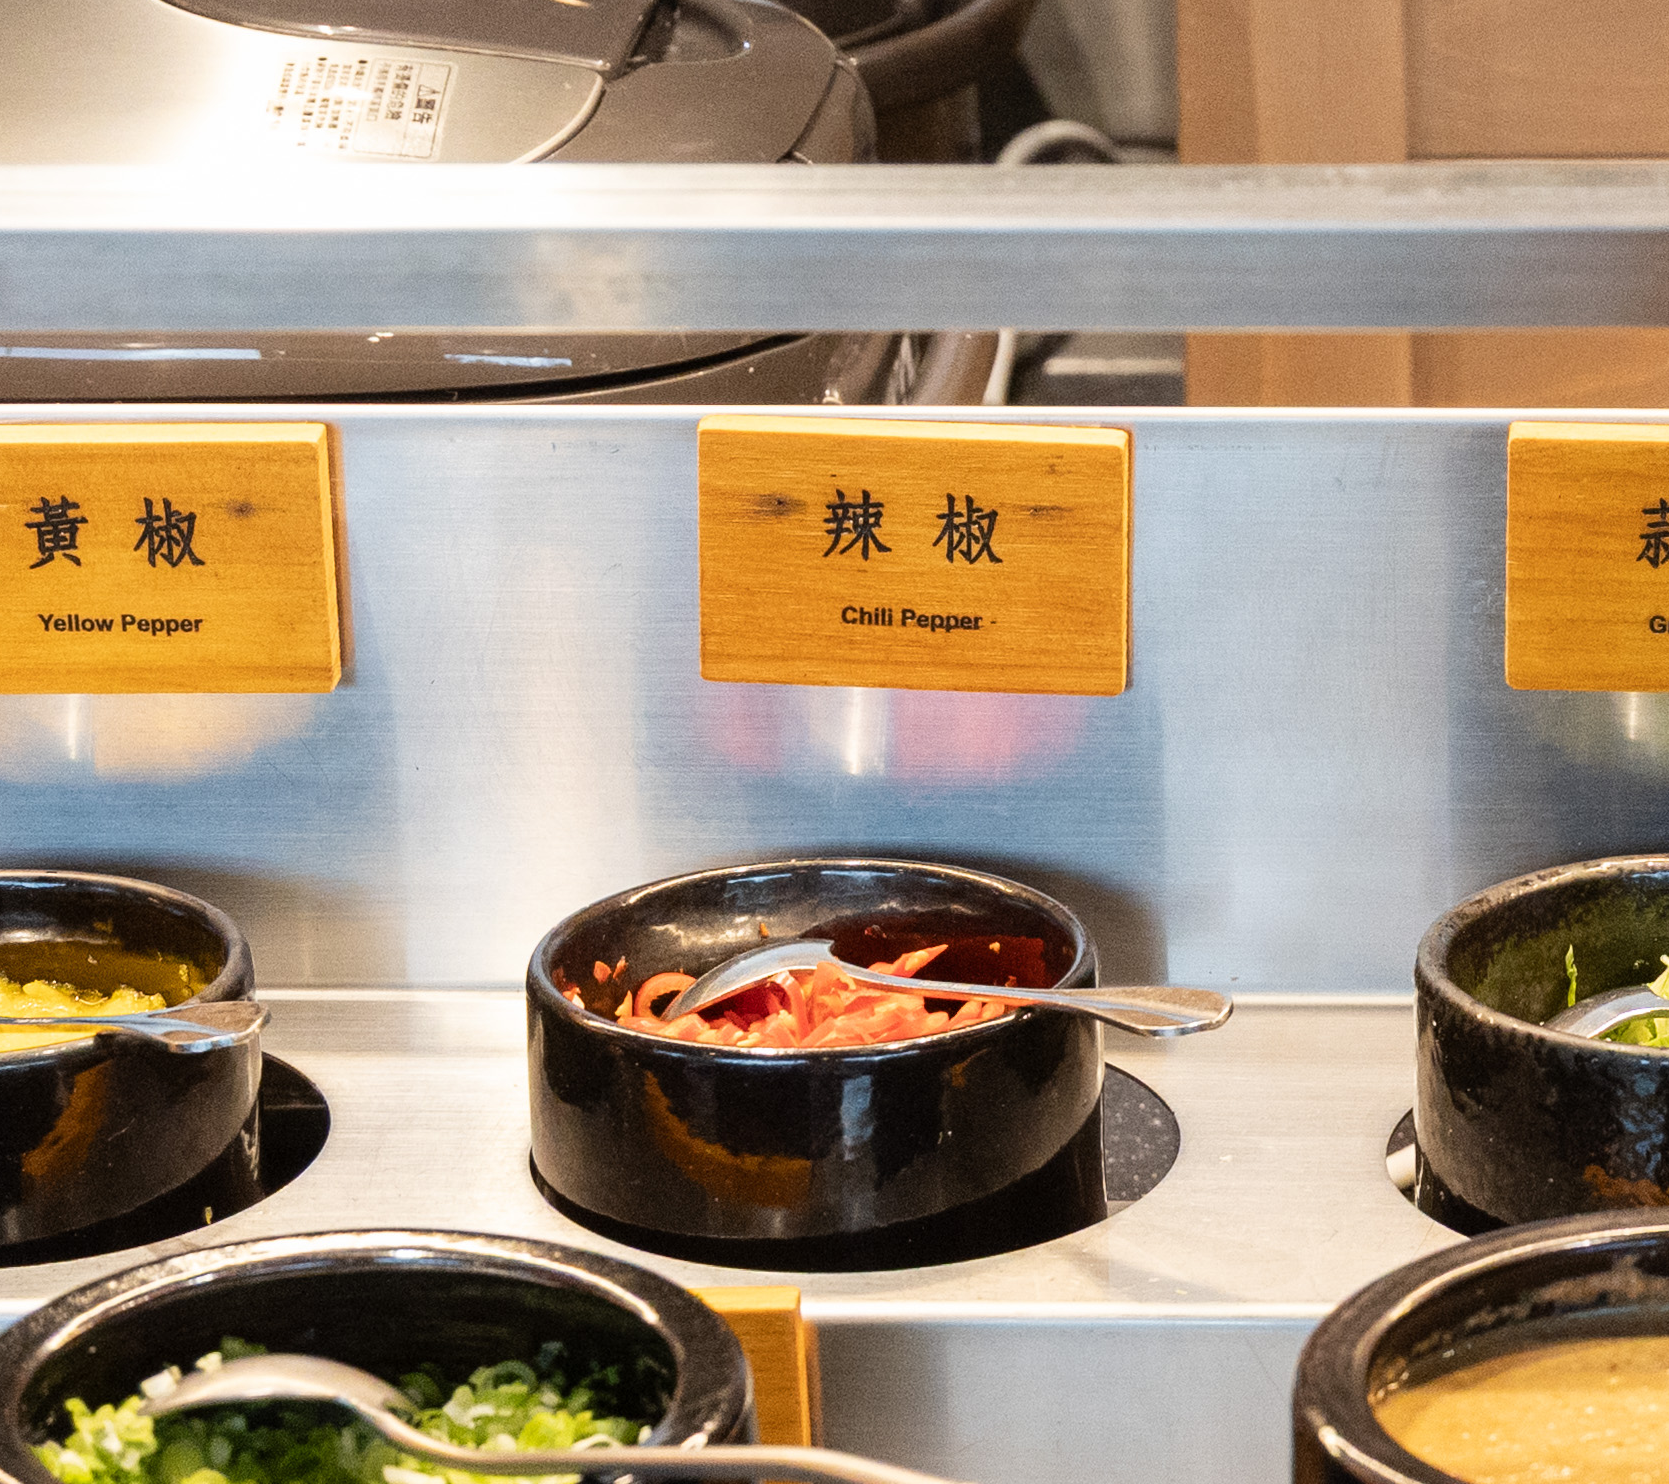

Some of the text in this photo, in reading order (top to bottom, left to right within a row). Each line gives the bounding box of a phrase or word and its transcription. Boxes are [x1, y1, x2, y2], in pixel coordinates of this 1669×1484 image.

[23, 494, 207, 570] 黃椒
[822, 487, 1004, 565] 辣椒
[36, 612, 203, 638] Yellow Pepper
[840, 604, 981, 634] Chili Pepper
